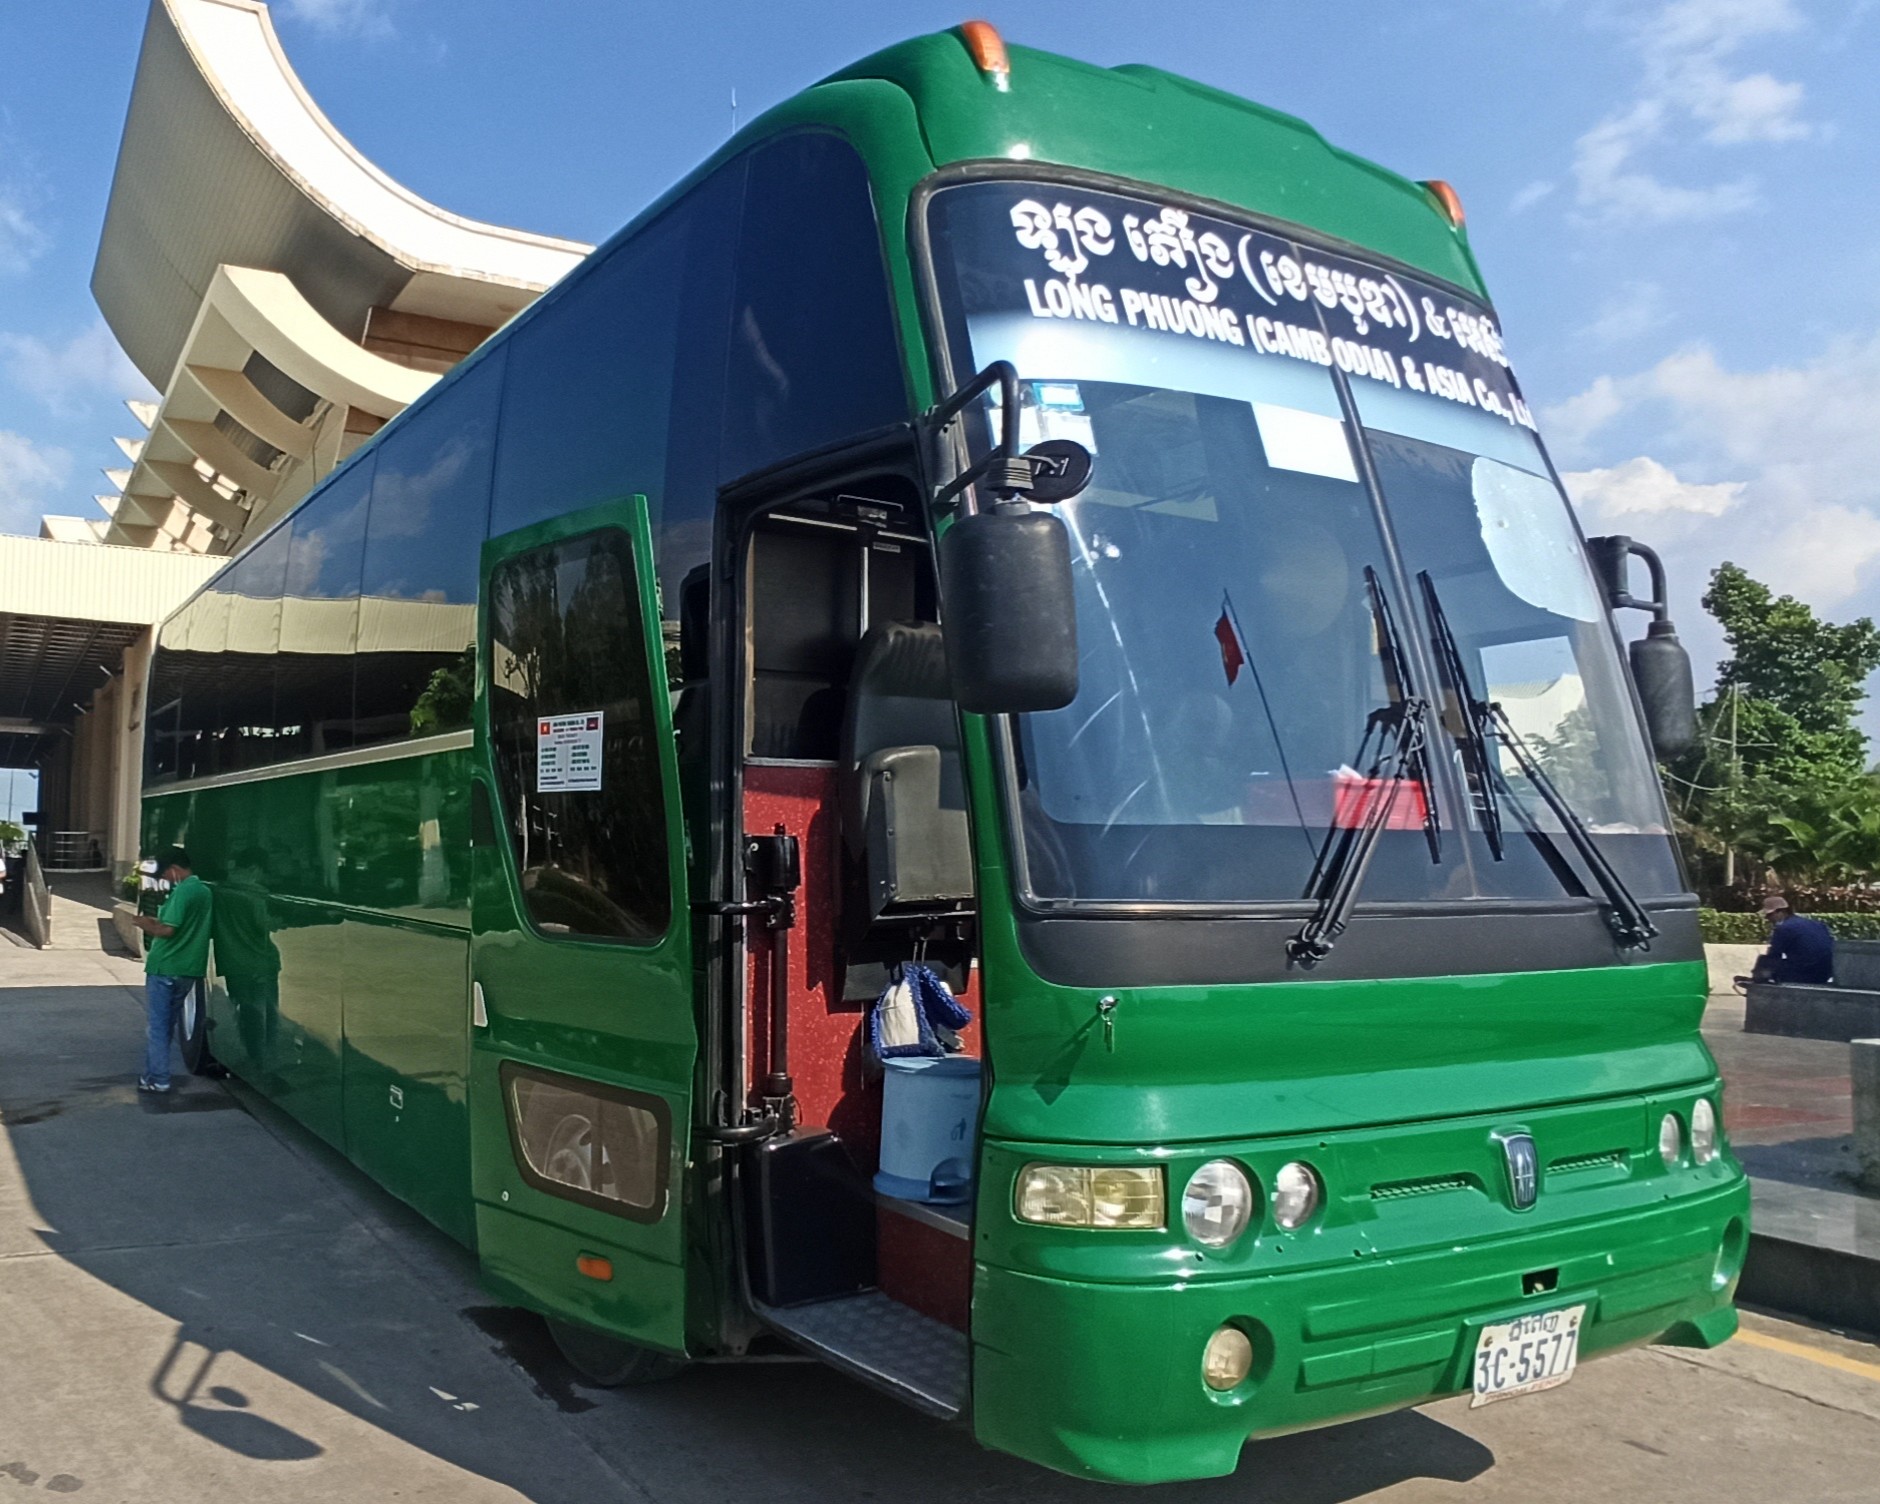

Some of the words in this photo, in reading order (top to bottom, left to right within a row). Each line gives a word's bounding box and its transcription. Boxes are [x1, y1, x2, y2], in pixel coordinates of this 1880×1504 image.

[1023, 278, 1119, 325] LONG
[1120, 288, 1245, 347] PHUONG
[1402, 356, 1426, 392] &
[1424, 362, 1477, 406] ASIA
[1421, 297, 1452, 339] &
